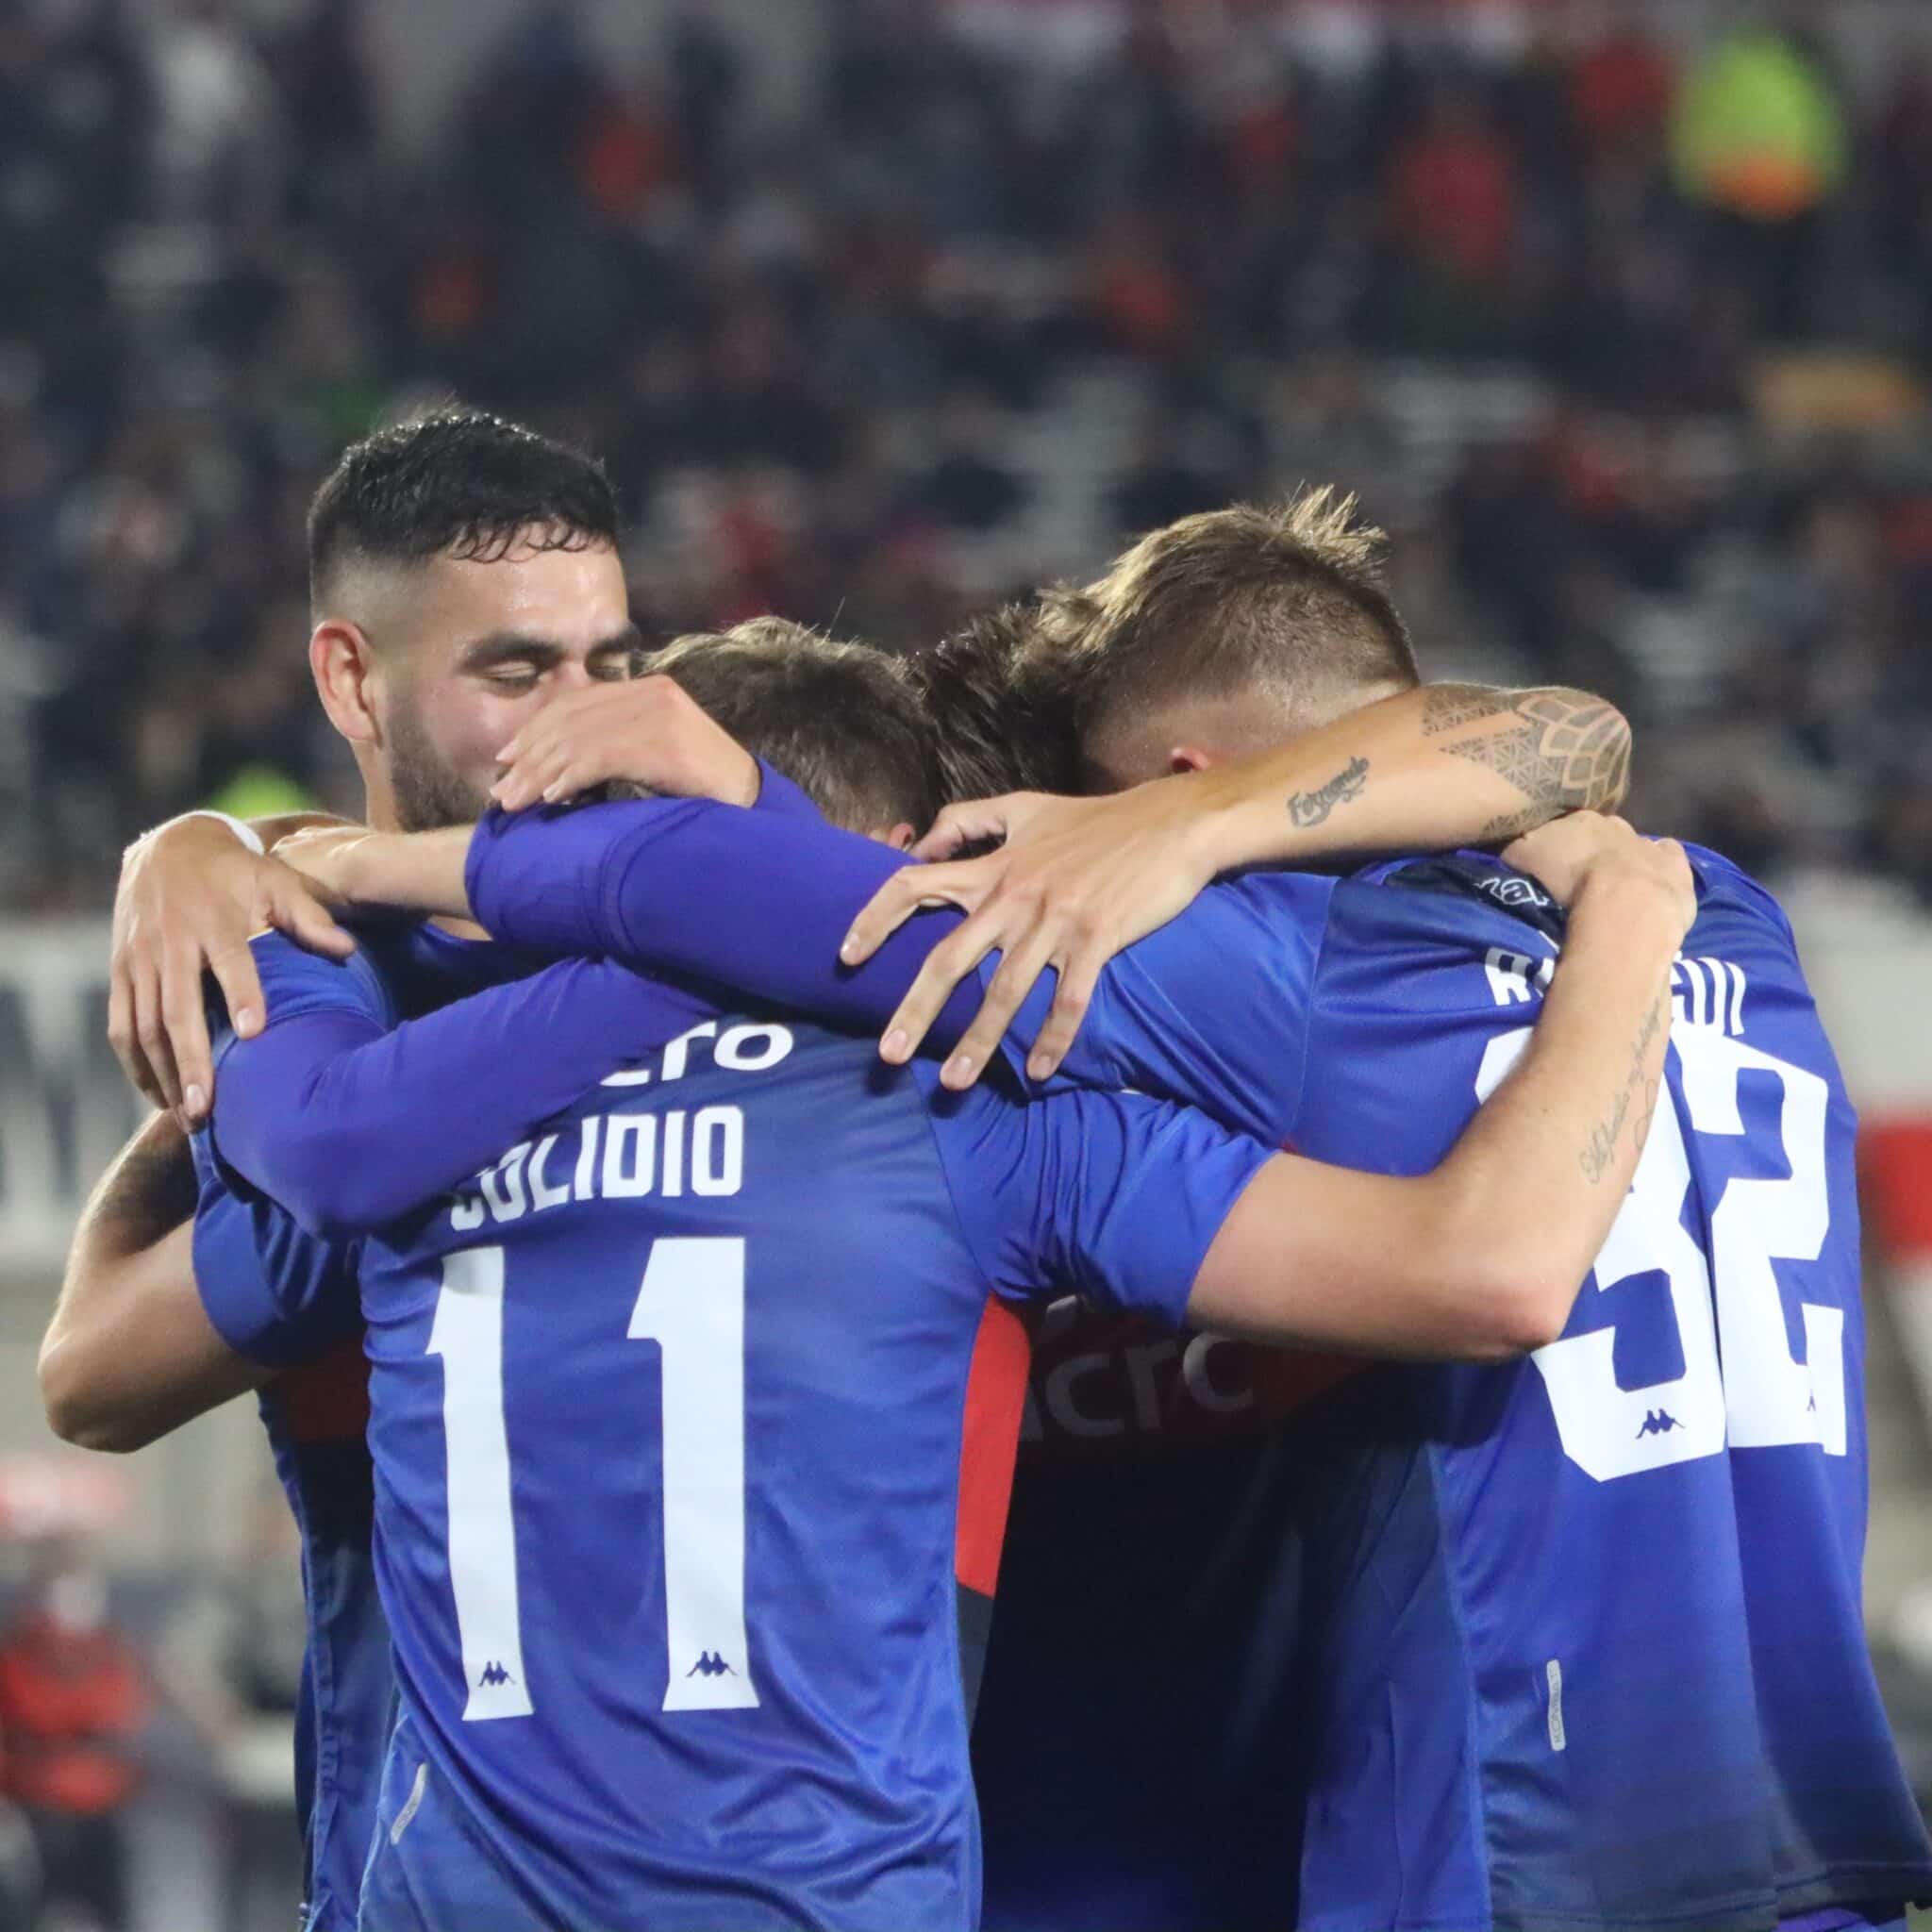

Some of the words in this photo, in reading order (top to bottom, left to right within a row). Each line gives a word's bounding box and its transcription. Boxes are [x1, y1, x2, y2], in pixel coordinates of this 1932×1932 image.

[425, 1237, 760, 1721] 11
[1018, 1331, 1257, 1442] cro
[1474, 1025, 1846, 1482] 32
